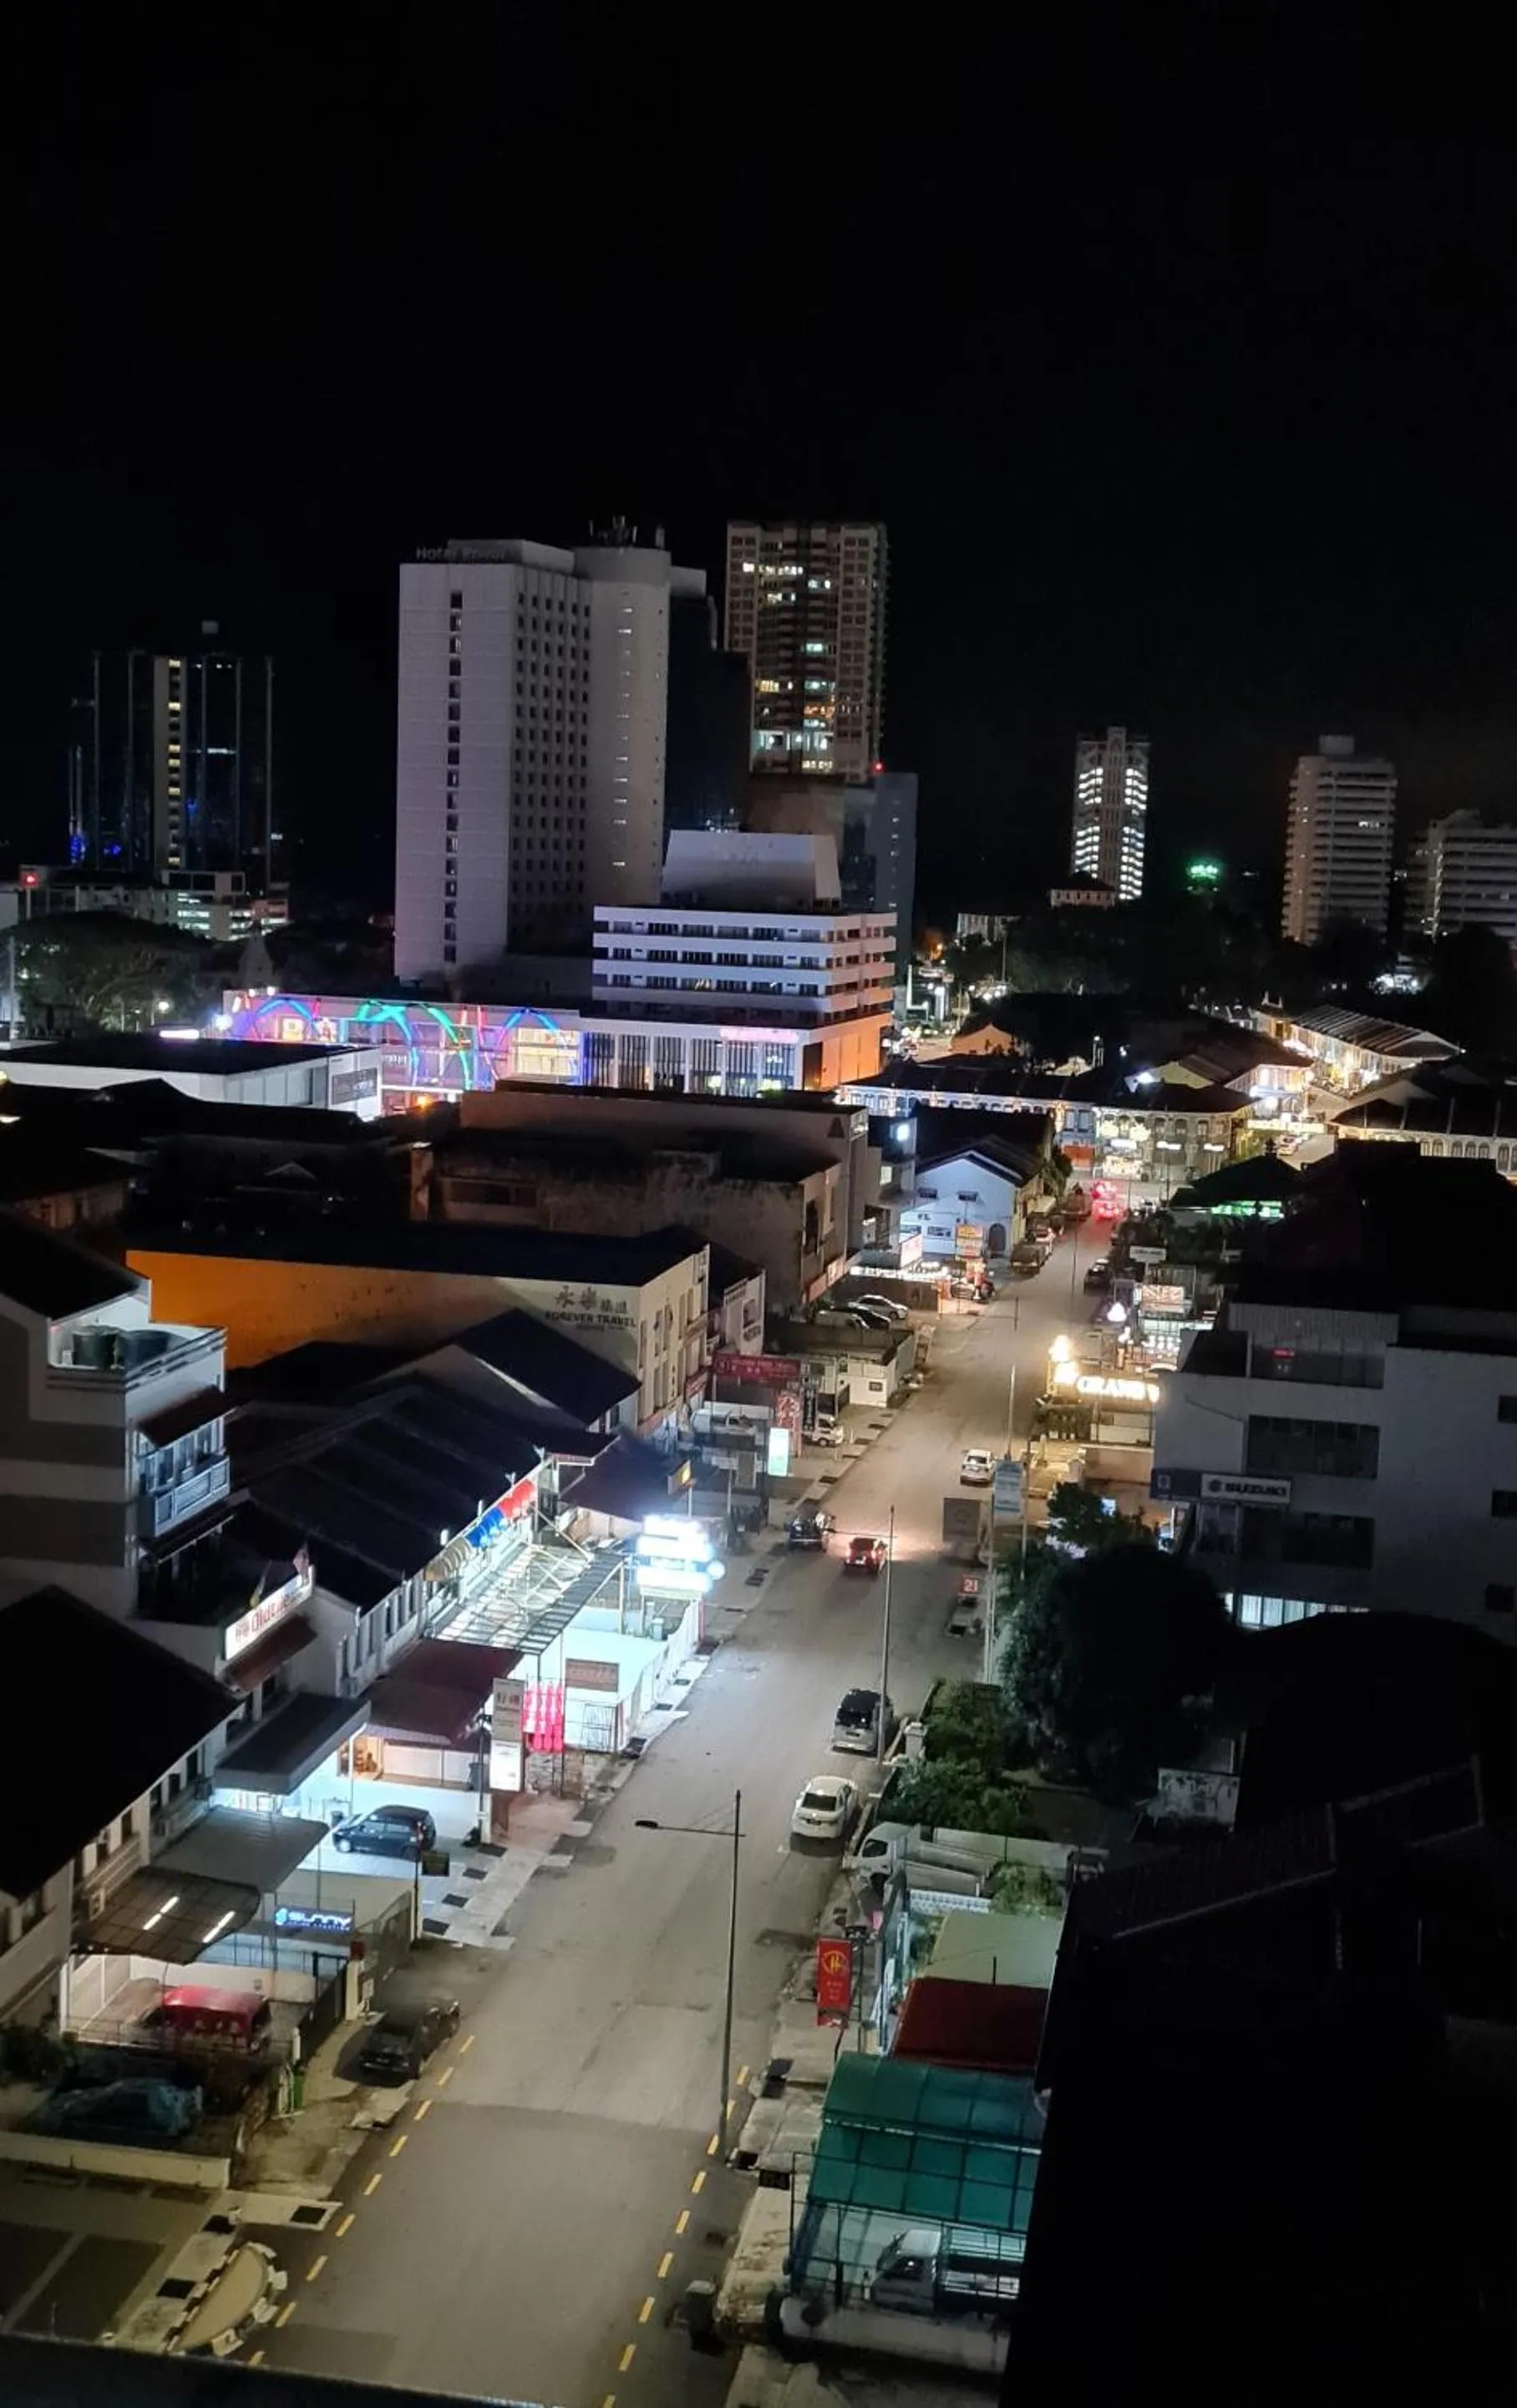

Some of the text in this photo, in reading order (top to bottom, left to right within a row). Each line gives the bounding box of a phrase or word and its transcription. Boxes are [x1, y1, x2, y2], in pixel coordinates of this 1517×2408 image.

[545, 1310, 594, 1324] FOREVER
[597, 1314, 637, 1328] TRAVEL
[1225, 1483, 1287, 1497] SUZUKI
